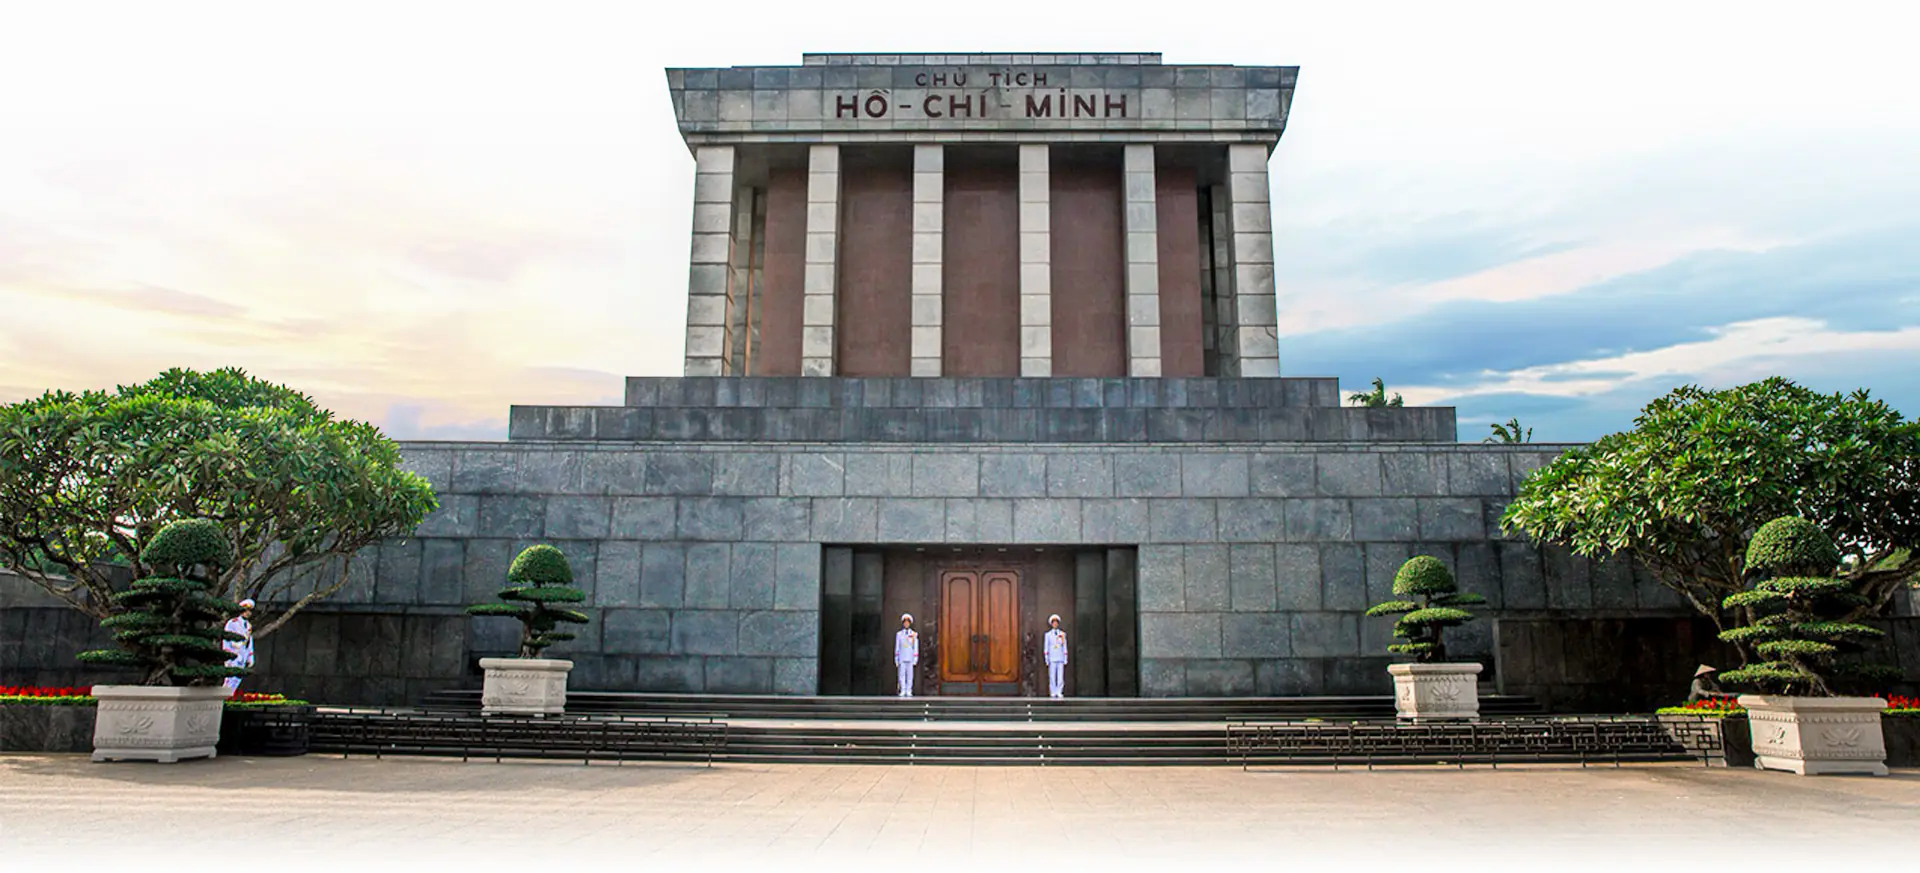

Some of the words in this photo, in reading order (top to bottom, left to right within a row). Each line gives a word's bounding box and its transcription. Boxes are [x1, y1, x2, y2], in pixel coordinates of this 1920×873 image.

[915, 67, 967, 87] CHỦ
[836, 89, 890, 118] HỒ
[923, 87, 993, 118] CHÍ
